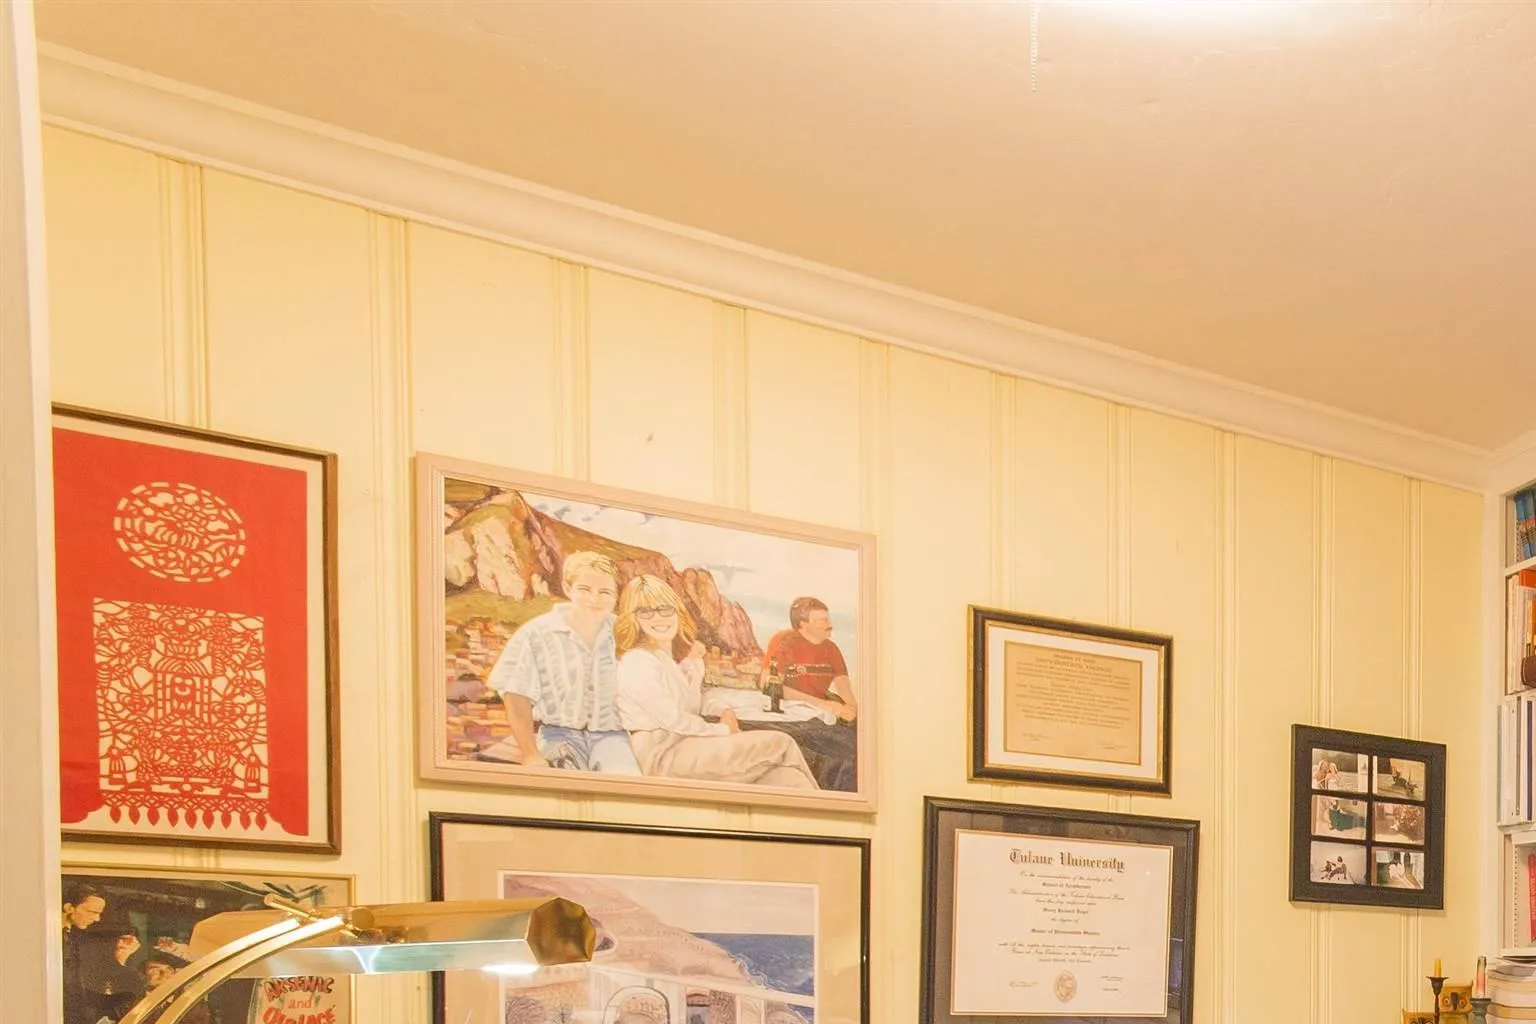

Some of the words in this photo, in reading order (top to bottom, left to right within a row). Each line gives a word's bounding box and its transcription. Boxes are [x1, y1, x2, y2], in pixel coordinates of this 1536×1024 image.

[1009, 848, 1054, 866] Tulane
[1059, 851, 1126, 874] University
[264, 976, 335, 1003] ARSENIC
[288, 995, 313, 1009] and
